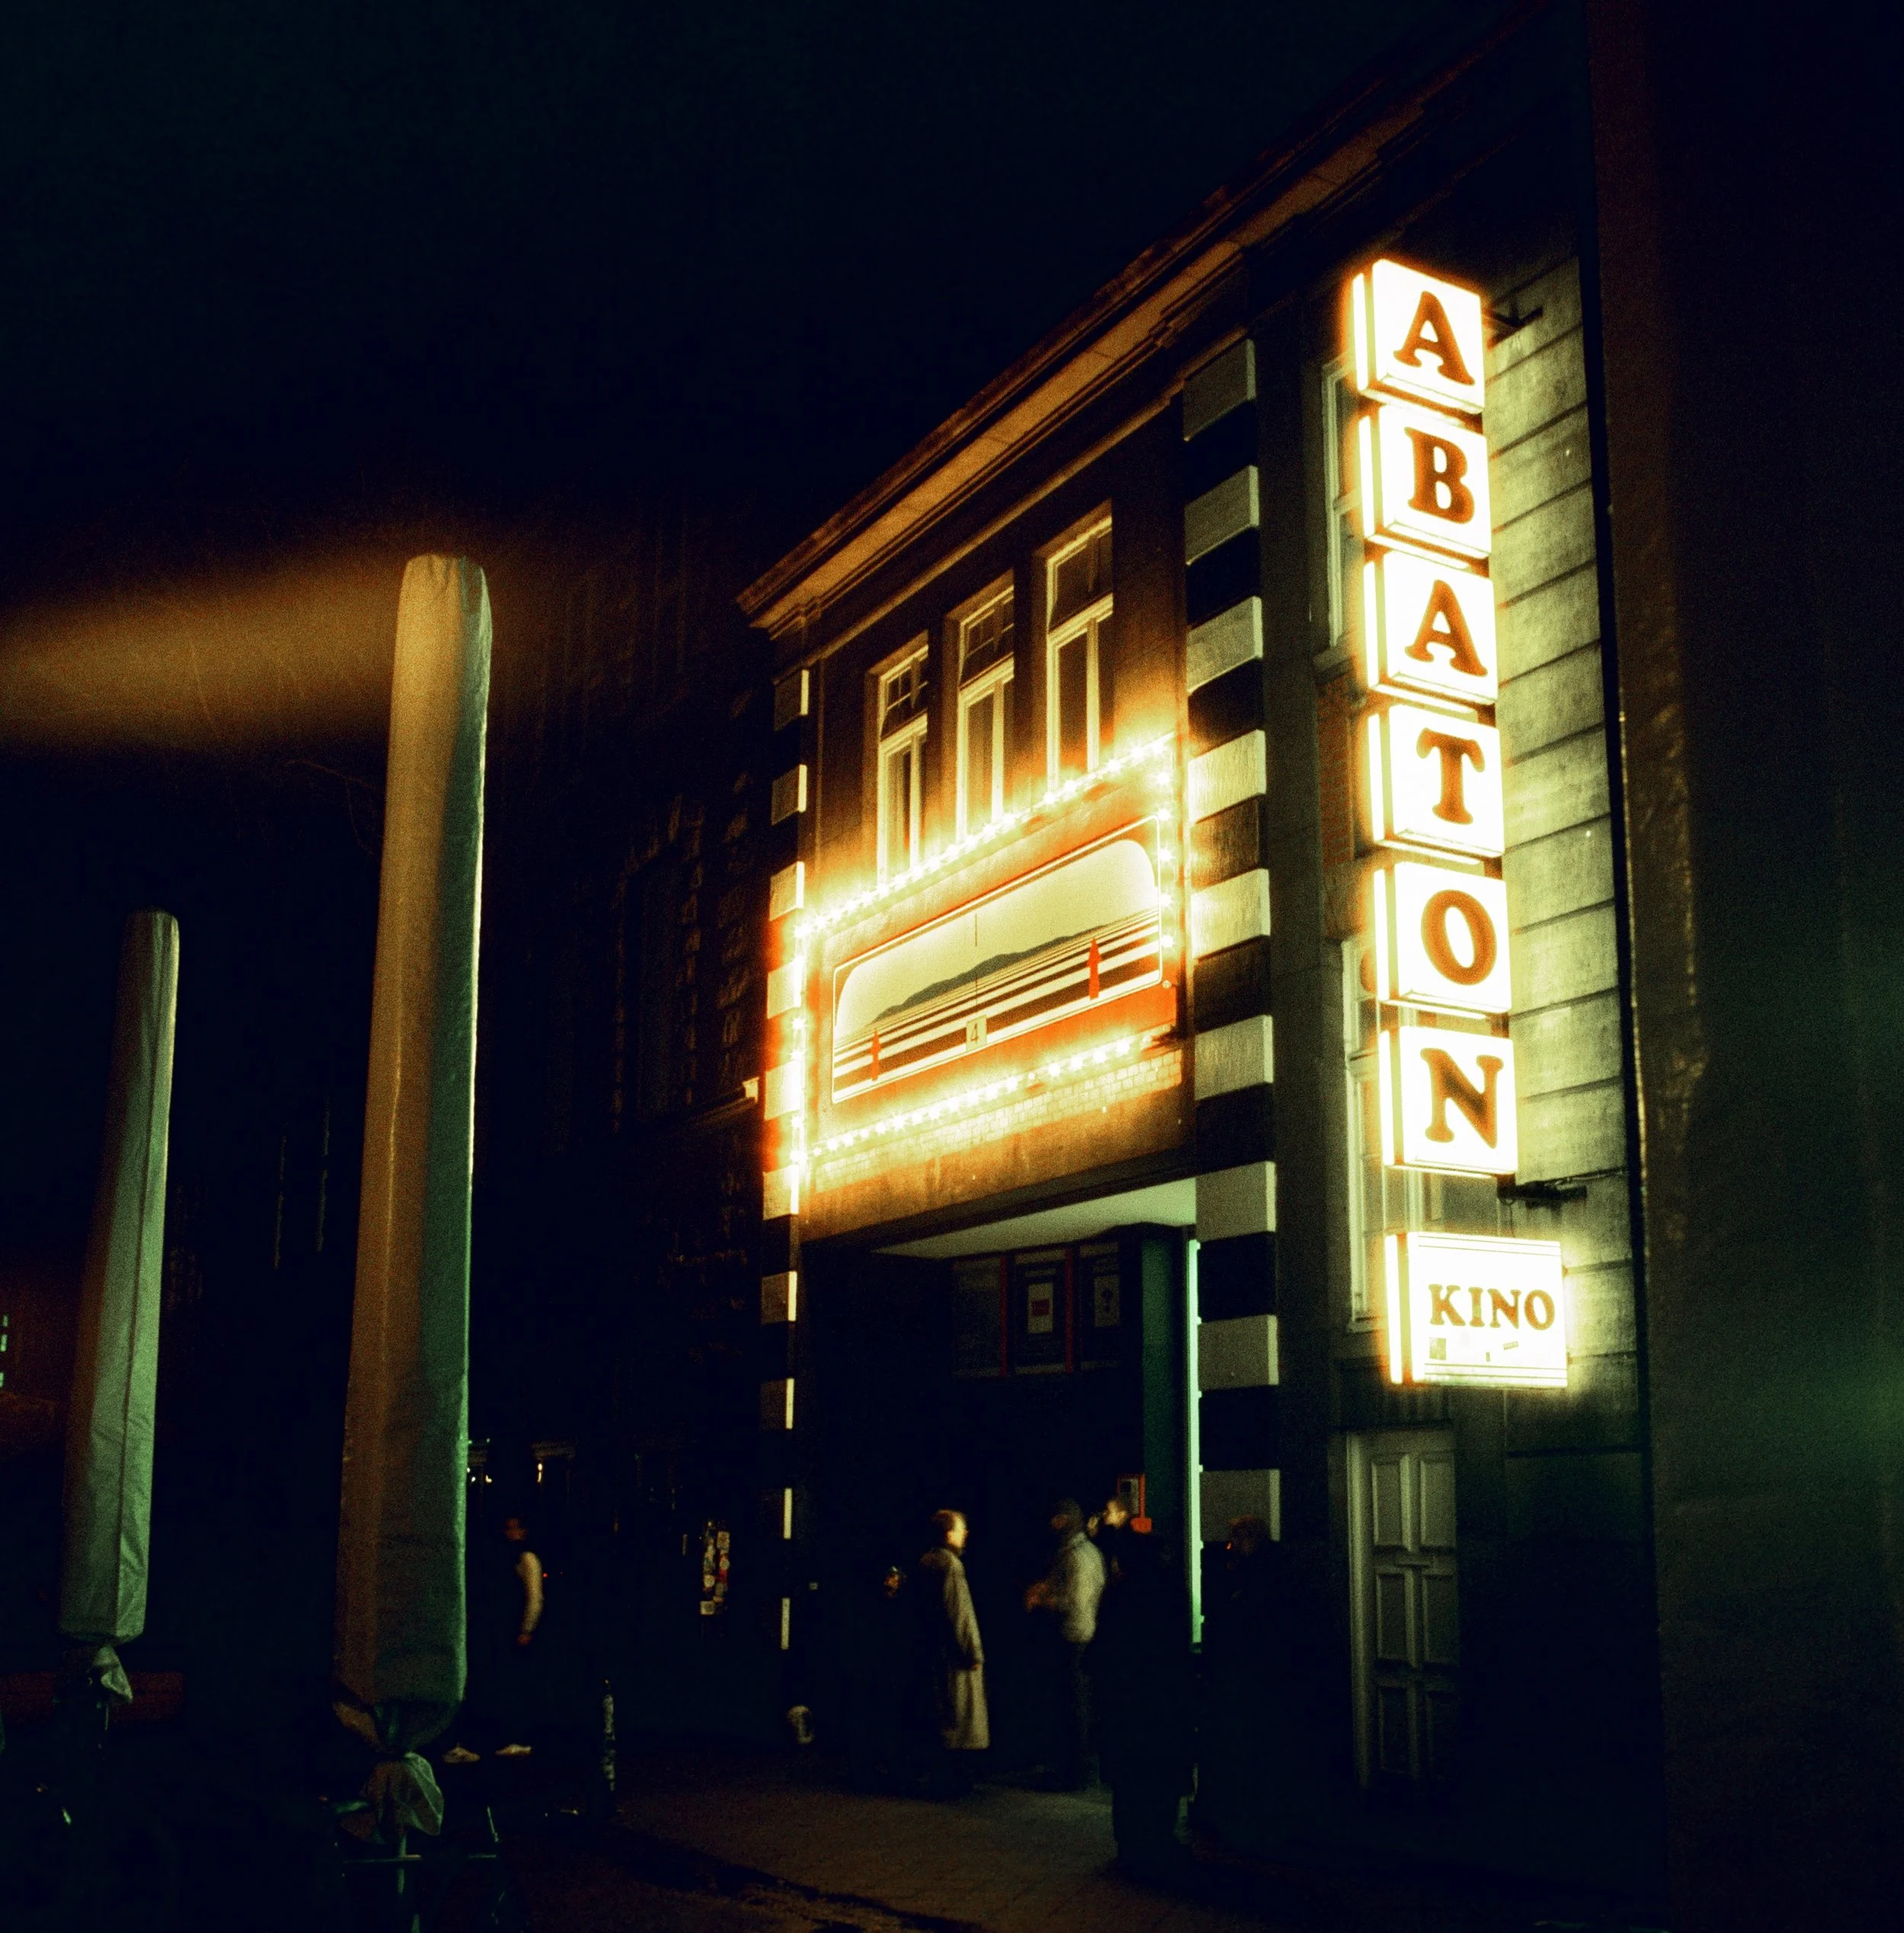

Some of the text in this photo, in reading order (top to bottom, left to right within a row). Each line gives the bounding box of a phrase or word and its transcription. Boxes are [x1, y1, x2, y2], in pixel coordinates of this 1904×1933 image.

[1393, 290, 1504, 1149] ABATON
[970, 1022, 979, 1044] 4
[1428, 1284, 1555, 1331] KINO
